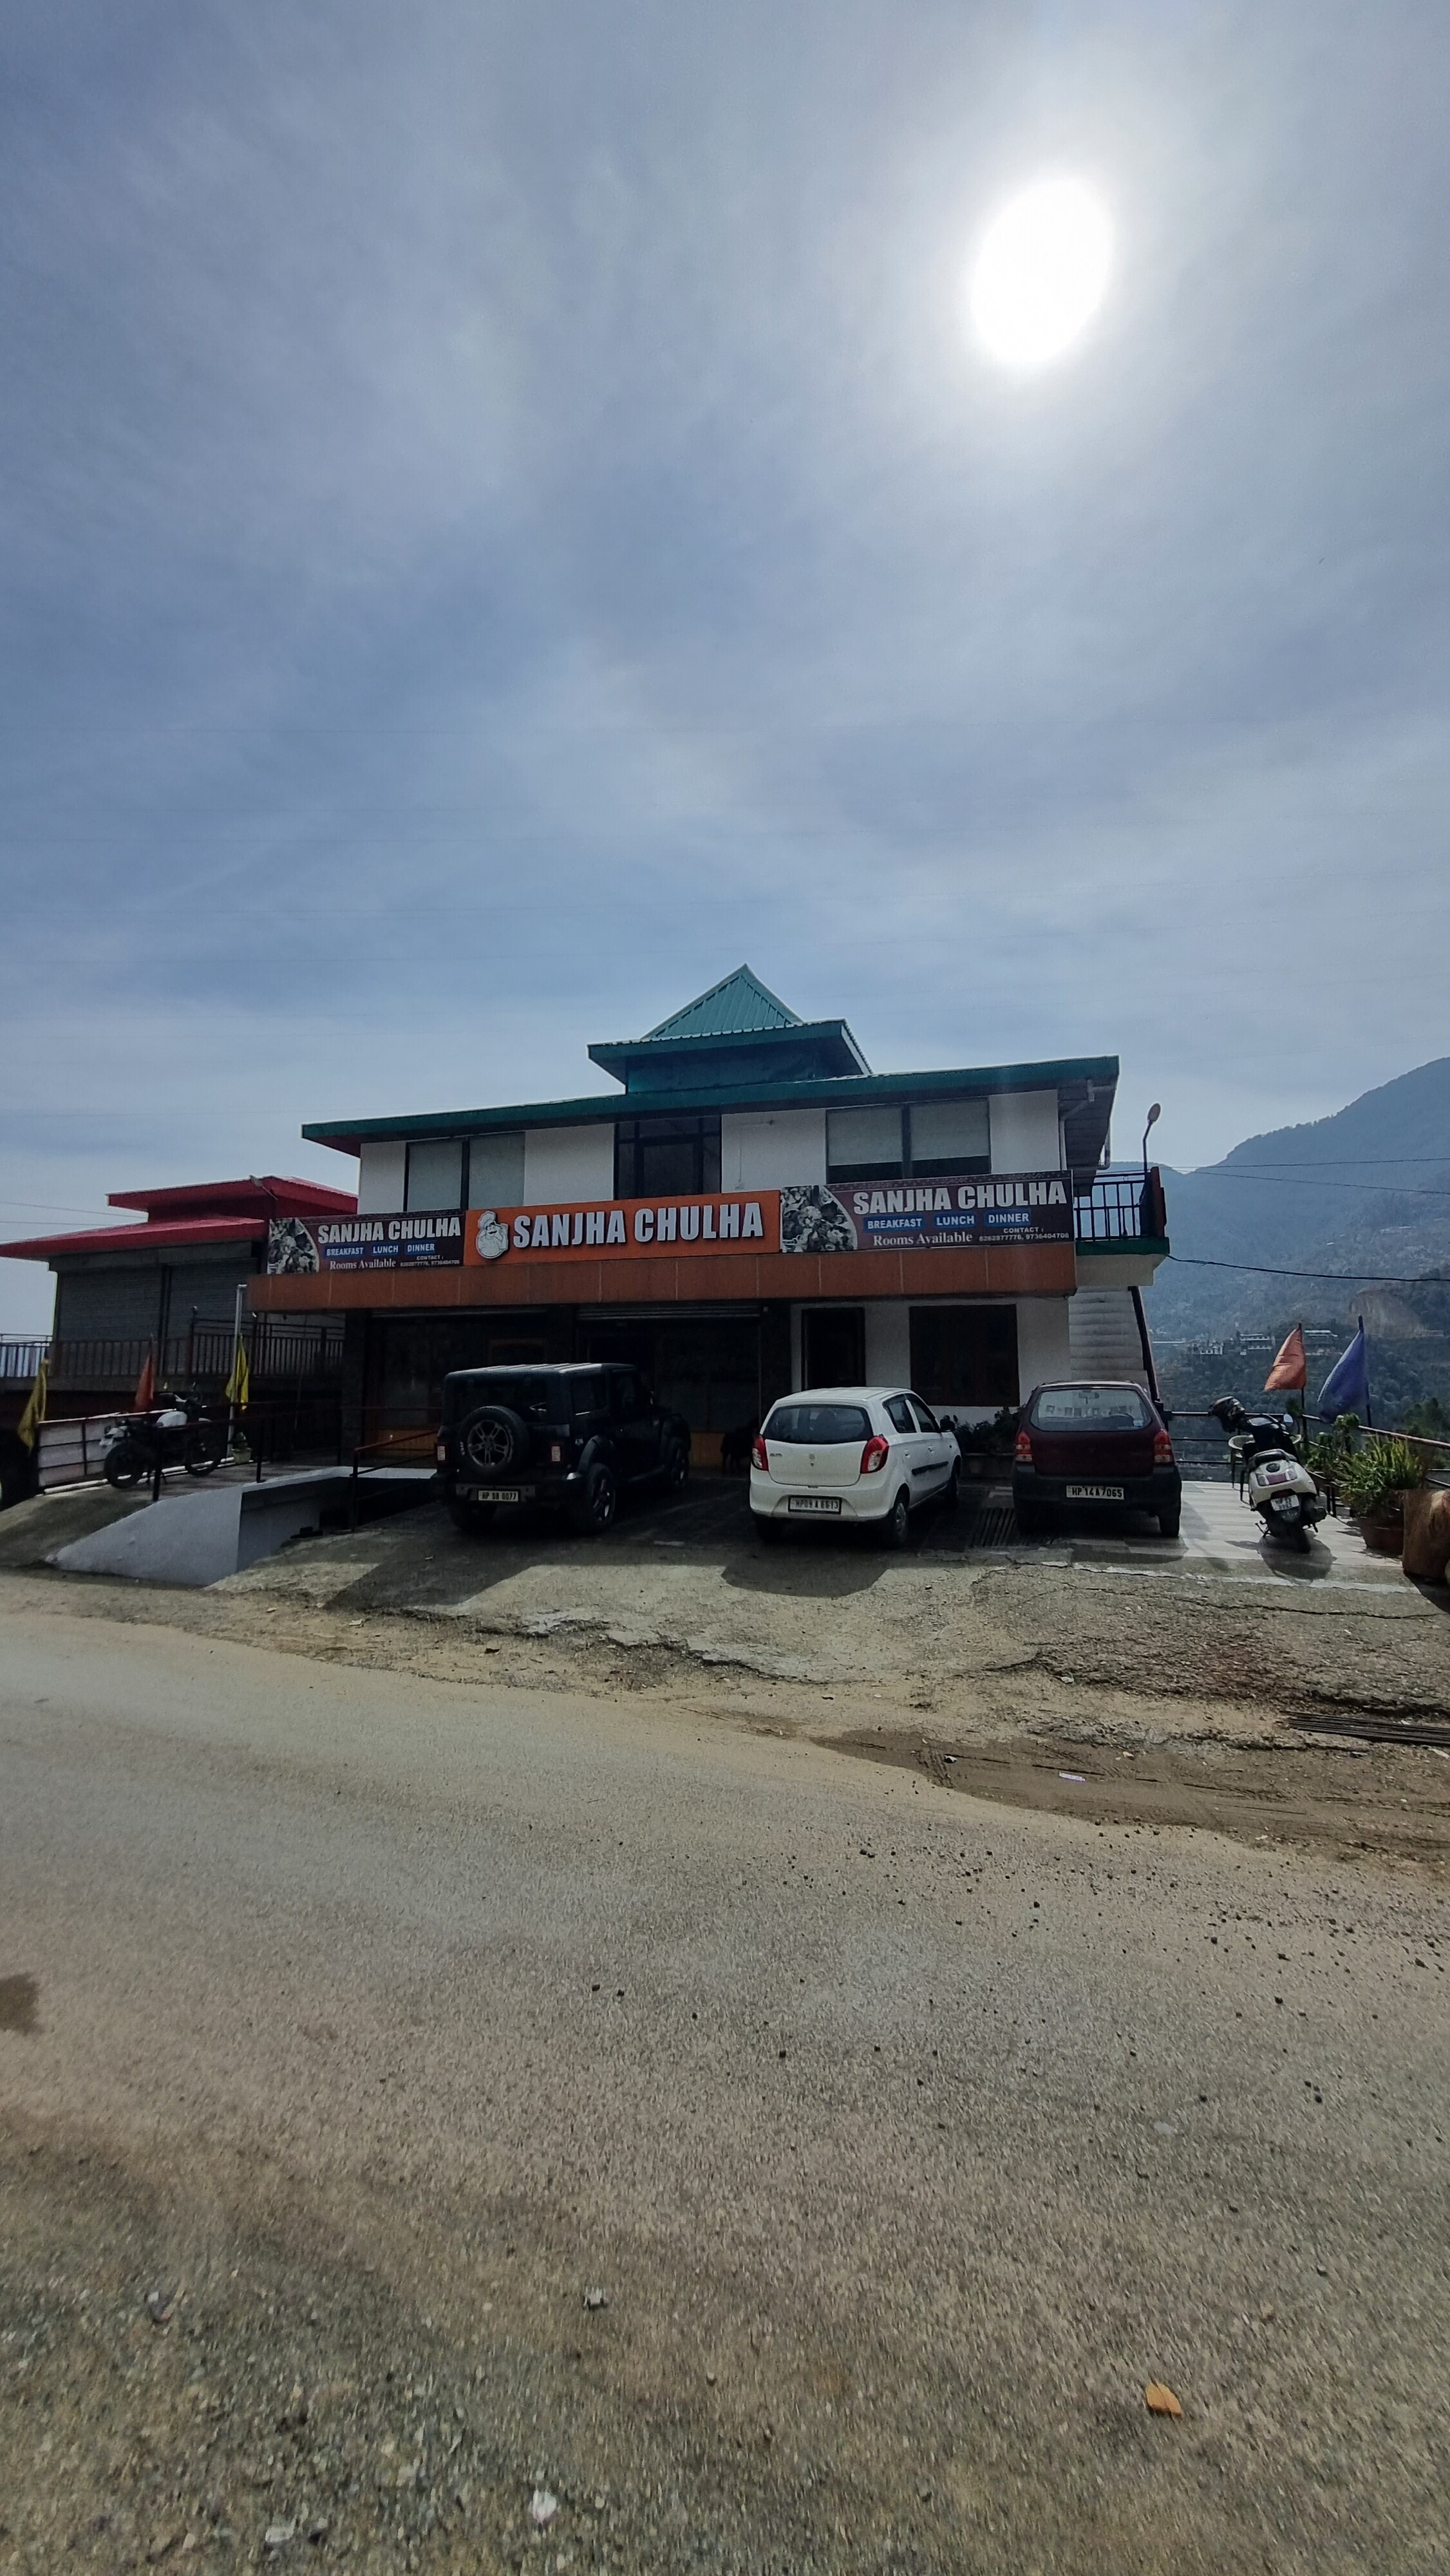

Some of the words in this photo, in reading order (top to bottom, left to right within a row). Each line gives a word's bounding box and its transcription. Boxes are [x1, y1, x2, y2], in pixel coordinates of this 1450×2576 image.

[853, 1188, 952, 1215] SANJHA
[958, 1181, 1068, 1209] CHULHA
[513, 1209, 626, 1248] SANJHA
[634, 1202, 763, 1243] CHULHA
[867, 1217, 922, 1230] BREAKFAST
[936, 1215, 975, 1226] LUNCH
[988, 1212, 1030, 1224] DINNER
[317, 1222, 384, 1244] SANJHA
[388, 1217, 461, 1240] CHULHA
[873, 1234, 914, 1247] Rooms
[916, 1232, 973, 1245] Available
[326, 1247, 364, 1256] BREAKFAST
[372, 1245, 399, 1255] LUNCH
[407, 1243, 435, 1253] DINNER
[330, 1259, 357, 1271] Rooms
[358, 1258, 397, 1269] Available
